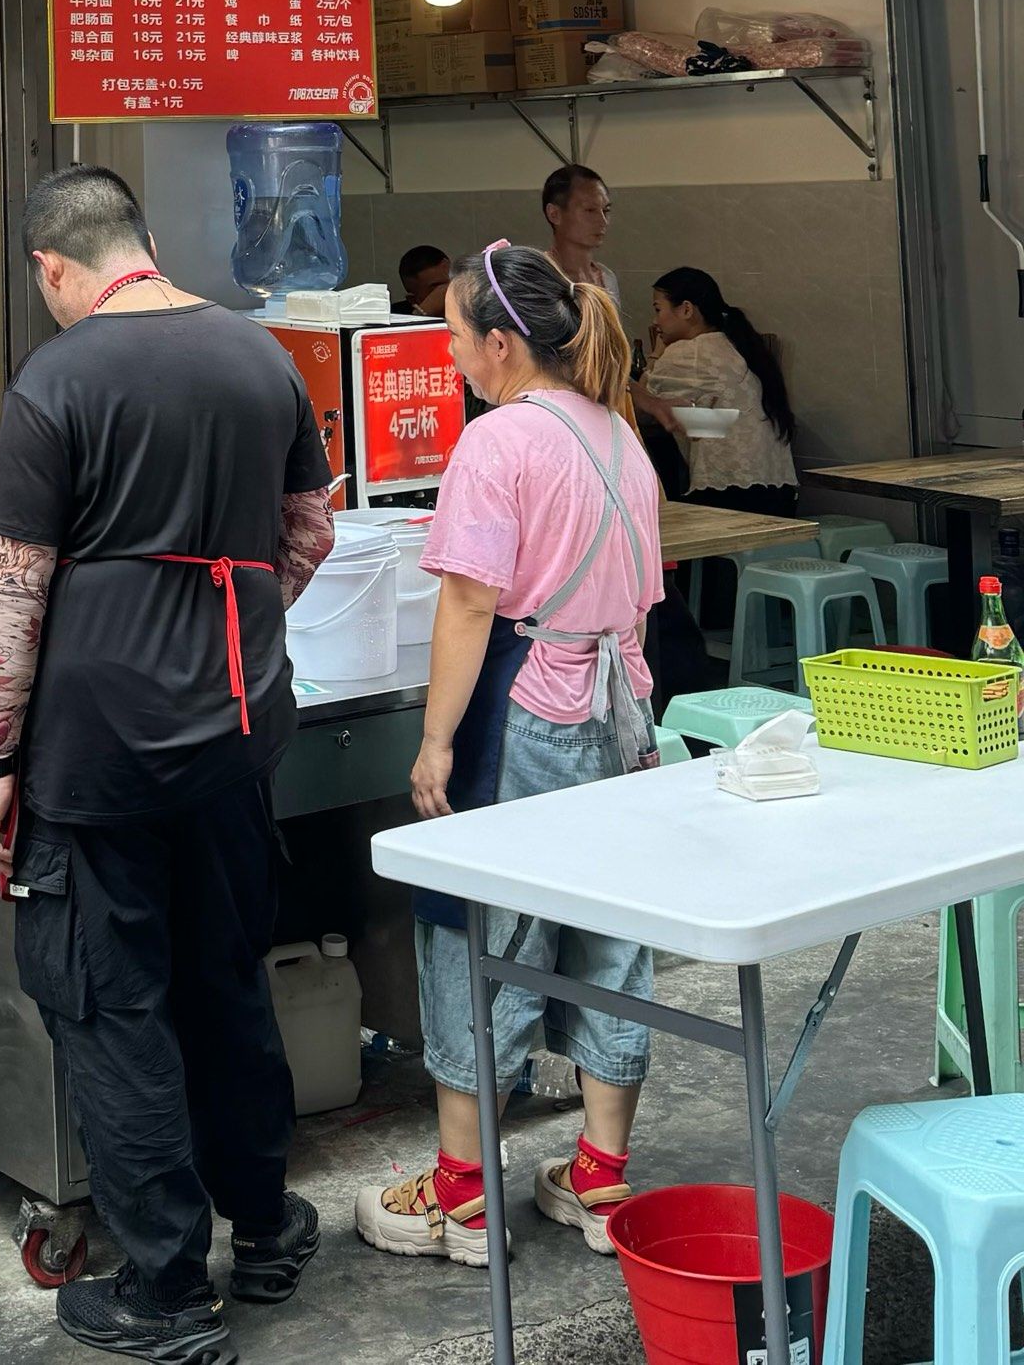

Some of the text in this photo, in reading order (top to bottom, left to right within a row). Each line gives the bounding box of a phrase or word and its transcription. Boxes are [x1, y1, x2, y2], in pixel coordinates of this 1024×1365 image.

[70, 13, 205, 26] 肥肠面 18元 21元
[316, 15, 353, 27] 1元/包
[70, 31, 206, 44] 混合面 18元 21元
[225, 31, 353, 44] 经典醇味豆浆 4元/杯
[71, 49, 206, 62] 鸡杂面 16元 19元
[311, 49, 360, 62] 各种饮料
[102, 78, 203, 91] 打包无盖+0.5元
[124, 96, 183, 109] 有盖+1元
[368, 364, 459, 403] 经典醇味豆浆
[388, 404, 439, 440] 4元/杯
